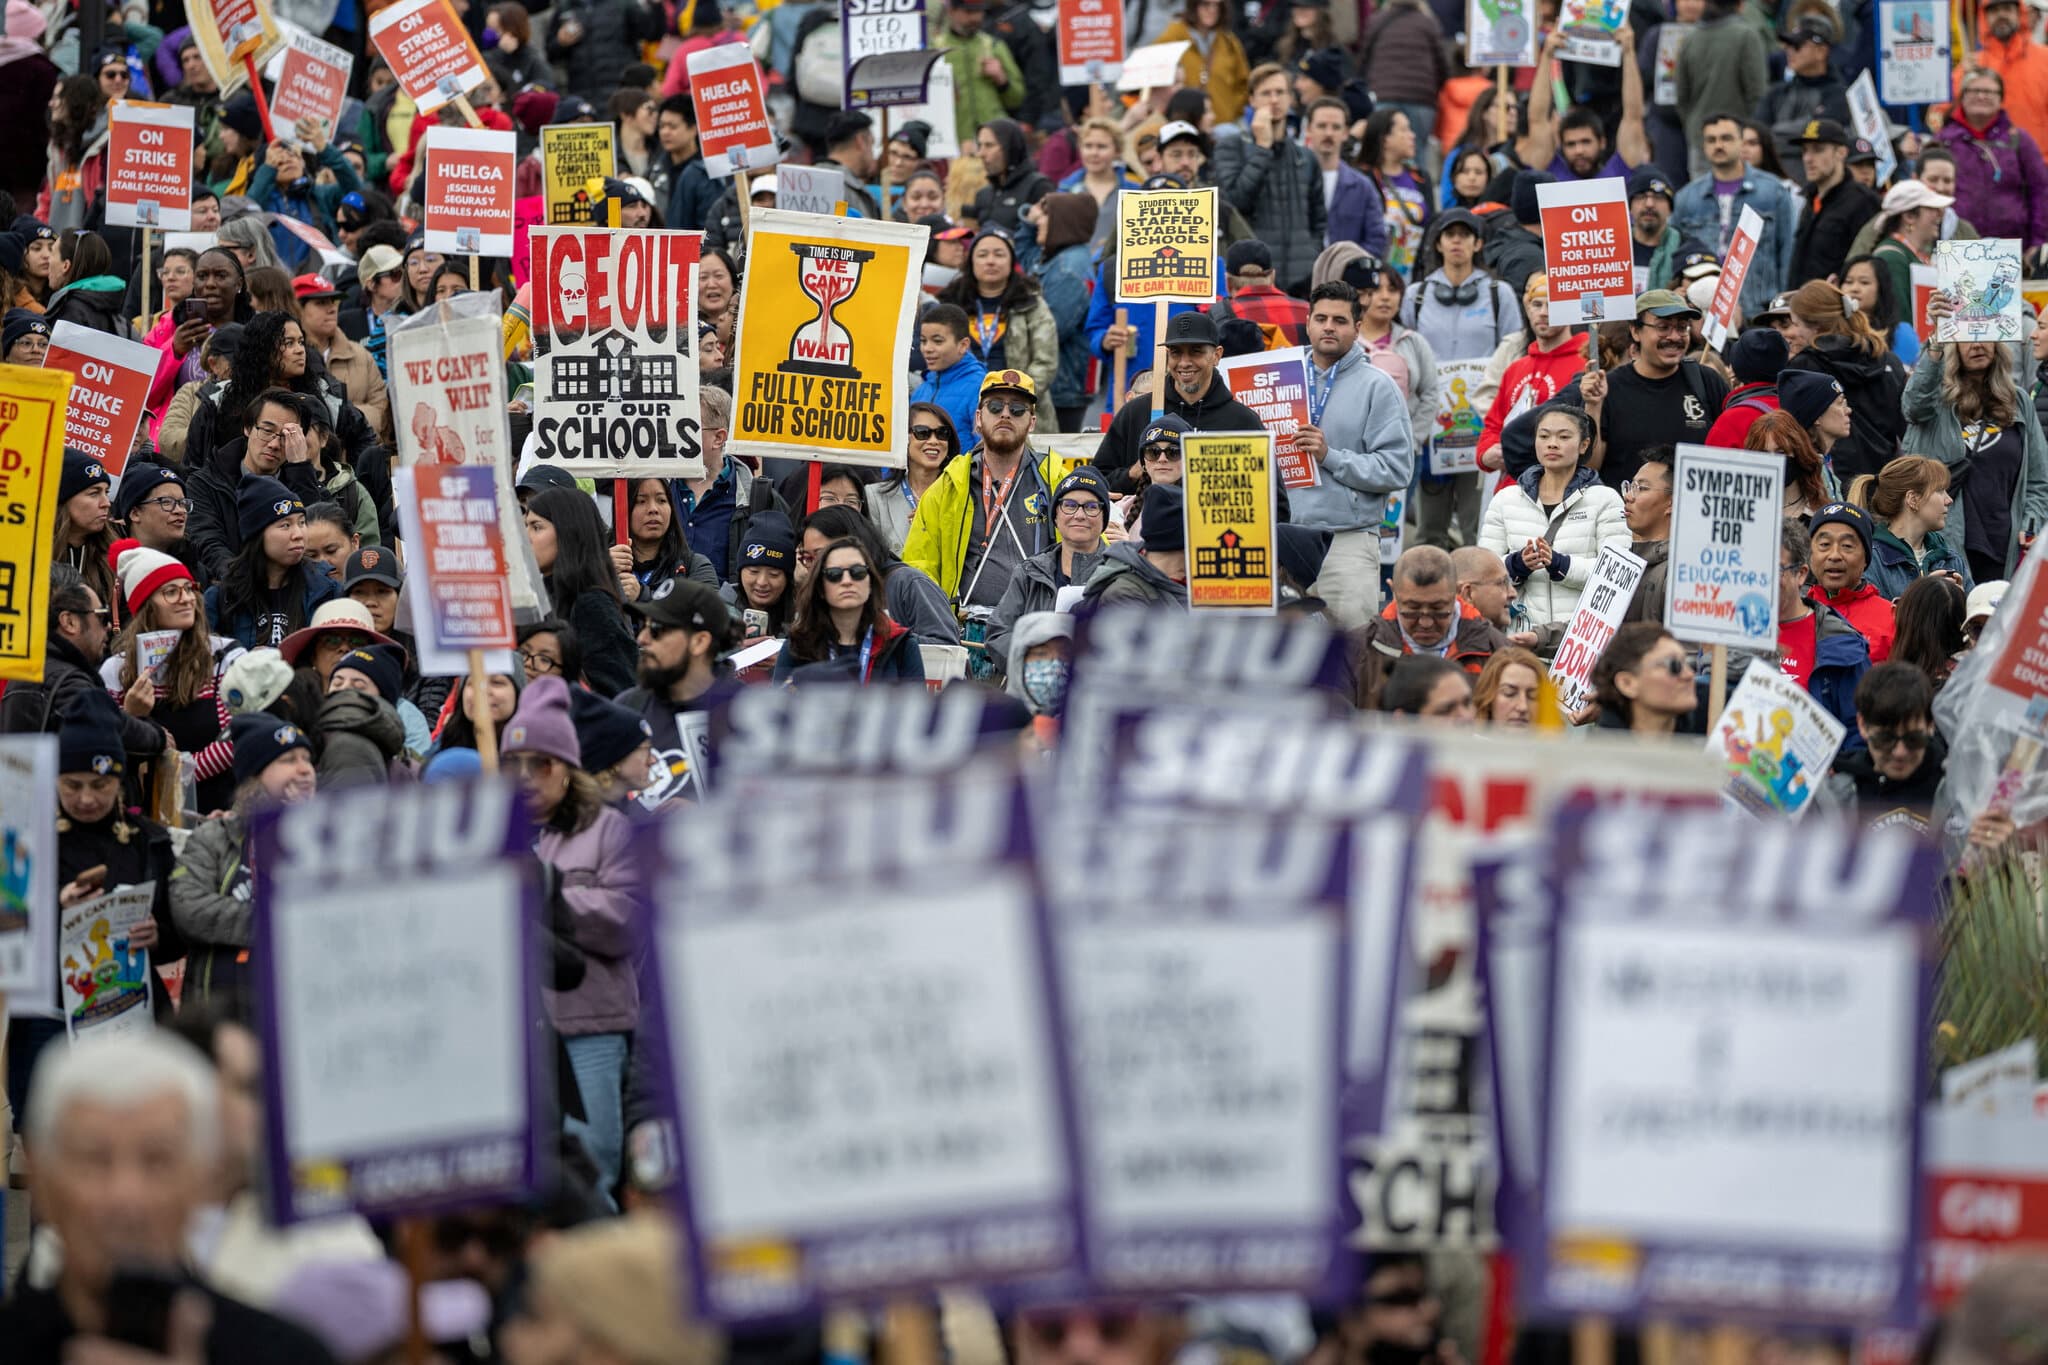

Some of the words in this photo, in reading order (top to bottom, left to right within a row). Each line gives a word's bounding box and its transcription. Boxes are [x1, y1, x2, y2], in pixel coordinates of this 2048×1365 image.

[1079, 0, 1103, 12] ON
[400, 12, 424, 33] ON
[862, 17, 902, 36] CEO
[1070, 14, 1113, 30] STRIKE
[398, 22, 446, 57] STRIKE
[404, 50, 425, 67] FOR
[424, 35, 450, 55] FULLY
[305, 60, 327, 80] ON
[400, 57, 437, 83] FUNDED
[436, 40, 468, 61] FAMILY
[412, 54, 470, 91] HEALTHCARE
[292, 73, 333, 100] STRIKE
[701, 79, 753, 102] HUELGA
[702, 125, 736, 140] ESTABLES
[735, 119, 768, 134] AHORA!
[711, 113, 745, 127] SEGURAS
[138, 130, 164, 146] ON
[547, 141, 589, 154] ESCUELAS
[592, 140, 609, 151] CON
[124, 149, 176, 168] STRIKE
[557, 152, 600, 164] PERSONAL
[118, 169, 136, 180] FOR
[138, 172, 160, 182] SAFE
[161, 174, 181, 184] AND
[438, 163, 504, 181] HUELGA
[555, 164, 600, 176] COMPLETO
[111, 181, 143, 192] STABLE
[144, 184, 186, 196] SCHOOLS
[447, 183, 496, 194] ¡ESCUELAS
[557, 176, 564, 187] Y
[781, 171, 813, 193] NO
[444, 194, 488, 206] SEGURAS
[488, 197, 496, 207] Y
[780, 194, 831, 214] PARAS
[1138, 198, 1177, 208] STUDENTS
[1179, 198, 1200, 208] NEED
[428, 204, 472, 217] ESTABLES
[473, 208, 511, 219] AHORA!
[1139, 206, 1197, 217] FULLY
[1571, 206, 1599, 224] ON
[1125, 215, 1210, 228] STAFFED,
[1131, 225, 1199, 237] STABLE
[1125, 235, 1210, 247] SCHOOLS
[1560, 228, 1616, 248] STRIKE
[809, 245, 829, 259] TIME
[830, 249, 840, 259] IS
[840, 251, 855, 261] UP!
[1561, 250, 1584, 262] FOR
[1585, 246, 1617, 260] FULLY
[815, 258, 849, 274] WE
[1549, 264, 1591, 279] FUNDED
[1592, 261, 1631, 275] FAMILY
[803, 273, 855, 291] CAN'T
[1123, 281, 1141, 293] WE
[1143, 279, 1174, 292] CAN'T
[1177, 280, 1208, 292] WAIT!
[1557, 276, 1625, 292] HEALTHCARE
[531, 233, 612, 359] ICE
[617, 234, 703, 359] OUT
[796, 338, 850, 361] WAIT
[81, 362, 114, 385] ON
[404, 359, 433, 386] WE
[437, 352, 488, 382] CAN'T
[1253, 371, 1281, 388] SF
[69, 384, 124, 416] TRIKE
[445, 383, 492, 412] WAIT
[750, 371, 816, 407] FULLY
[820, 378, 883, 413] STAFF
[1235, 388, 1274, 405] STANDS
[1275, 384, 1303, 401] WITH
[65, 406, 80, 419] OR
[82, 411, 110, 428] SPED
[575, 402, 606, 416] OF
[619, 403, 672, 417] OUR
[1250, 402, 1293, 420] TRIKING
[742, 401, 785, 435] OUR
[790, 406, 886, 444] SCHOOLS
[65, 422, 102, 441] DENTS
[102, 433, 112, 444] &
[475, 425, 495, 445] for
[534, 416, 703, 460] SCHOOLS
[64, 436, 107, 458] CATORS
[1199, 444, 1253, 457] NECESITAMOS
[1275, 443, 1299, 456] UDENT
[1189, 457, 1240, 473] ESCUELAS
[1242, 455, 1265, 472] CON
[1291, 467, 1306, 479] FOR
[440, 476, 470, 498] SF
[1200, 474, 1253, 491] PERSONAL
[1685, 467, 1773, 500] SYMPATHY
[1198, 491, 1254, 508] COMPLETO
[1701, 494, 1757, 523] STRIKE
[421, 498, 464, 522] STANDS
[466, 498, 497, 522] WITH
[1200, 508, 1208, 525] Y
[1211, 508, 1256, 524] ESTABLE
[1711, 520, 1743, 546] FOR
[767, 549, 784, 559] UESF
[1700, 548, 1743, 567] OUR
[1594, 552, 1608, 575] IF
[1603, 557, 1619, 582] WE
[1677, 563, 1771, 588] EDUCATORS
[1590, 584, 1610, 612] GET
[1694, 583, 1721, 602] MY
[1571, 608, 1604, 645] SHUT
[1087, 613, 1330, 688] SEIU
[1751, 675, 1771, 689] WE
[1774, 683, 1809, 710] CAN'T
[728, 682, 985, 773] SEIU
[1130, 714, 1408, 806] SEIU
[279, 783, 508, 868] SEIU
[655, 776, 1014, 895] SEIU
[1580, 813, 1914, 913] SEIU
[63, 916, 83, 932] WE
[1939, 1184, 2021, 1232] ON
